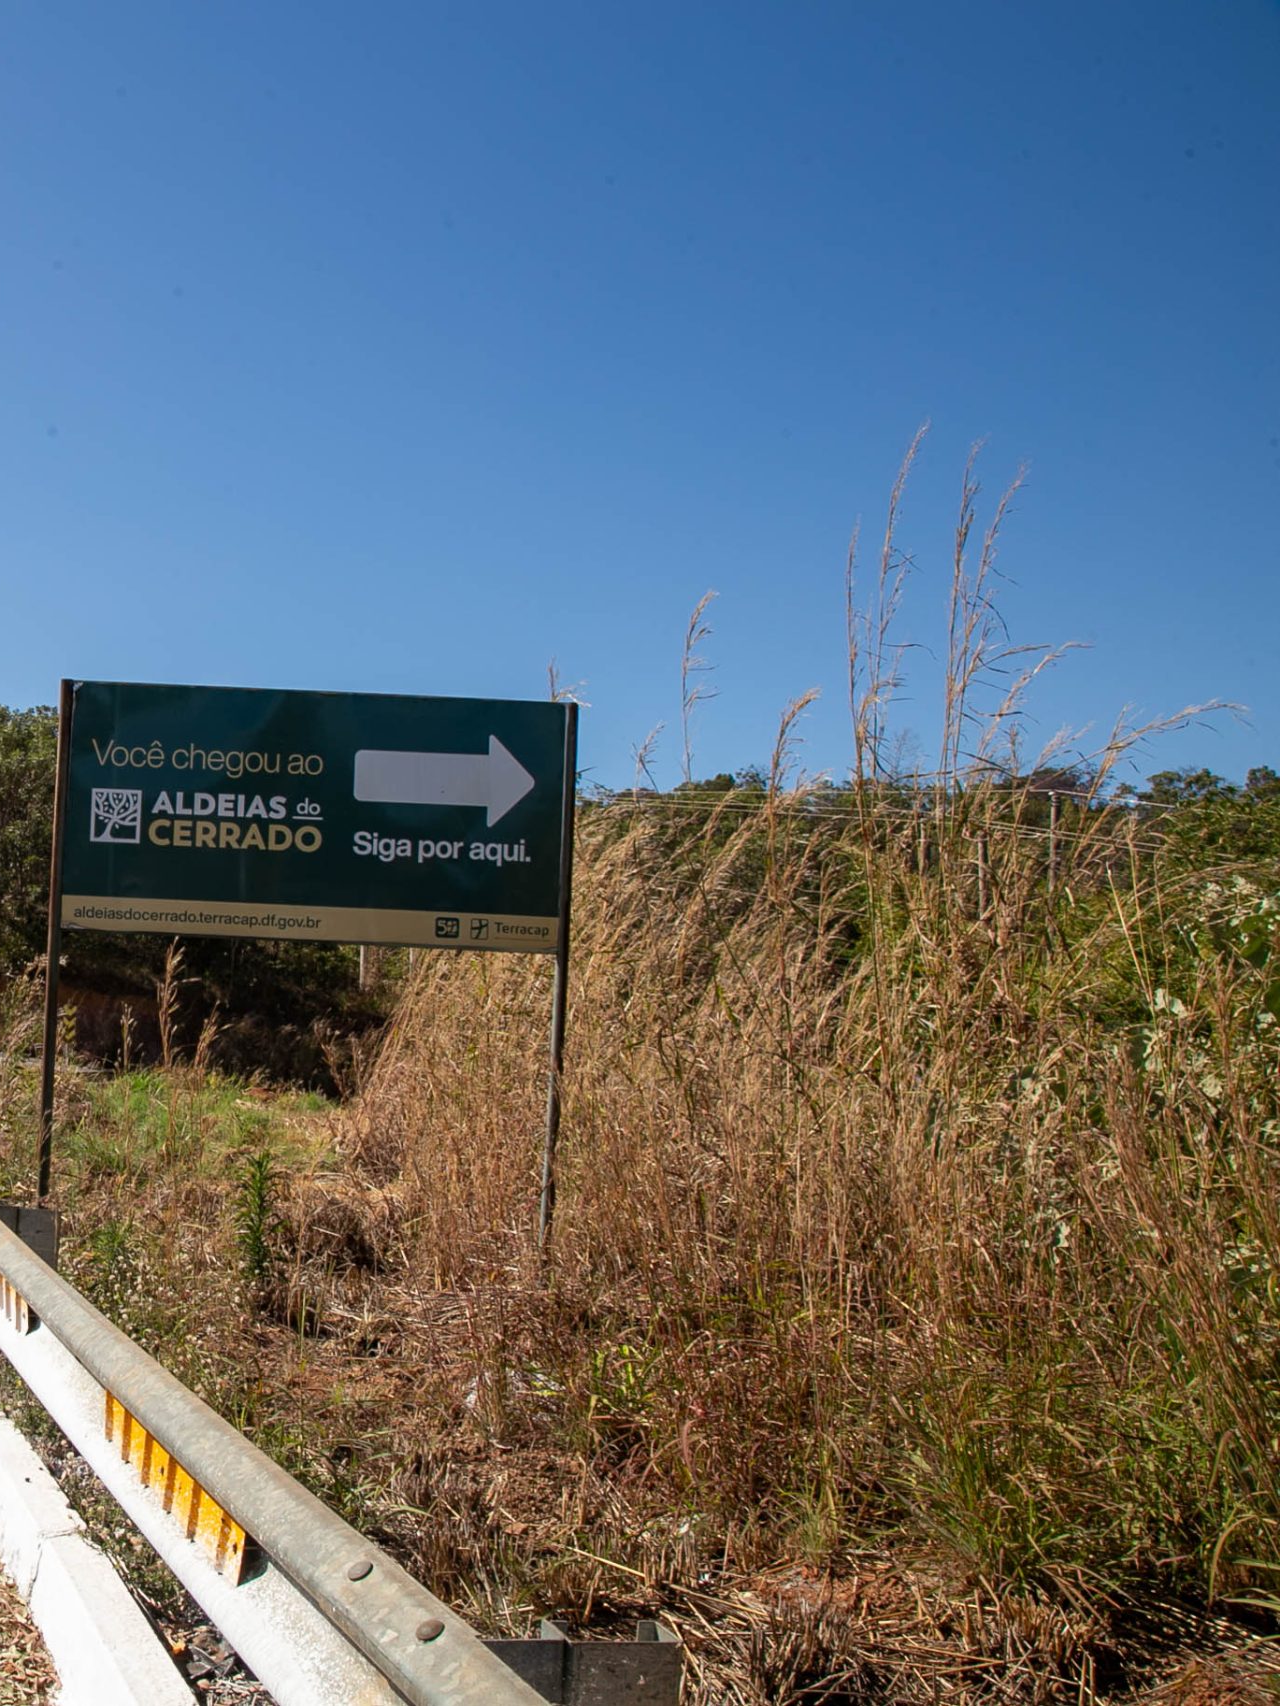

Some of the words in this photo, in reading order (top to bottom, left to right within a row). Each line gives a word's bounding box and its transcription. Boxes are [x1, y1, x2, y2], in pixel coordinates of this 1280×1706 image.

[91, 738, 165, 769] Você
[171, 743, 281, 779] chegou
[287, 752, 324, 776] ao
[150, 790, 288, 820] ALDEIAS
[296, 797, 322, 817] do
[147, 818, 323, 853] CERRADO
[352, 830, 413, 863] Siga
[417, 838, 464, 864] por
[468, 838, 532, 867] aqui.
[73, 905, 323, 930] aldeiasdocerrado.terracap.df.gov.br
[494, 921, 550, 938] Terracap
